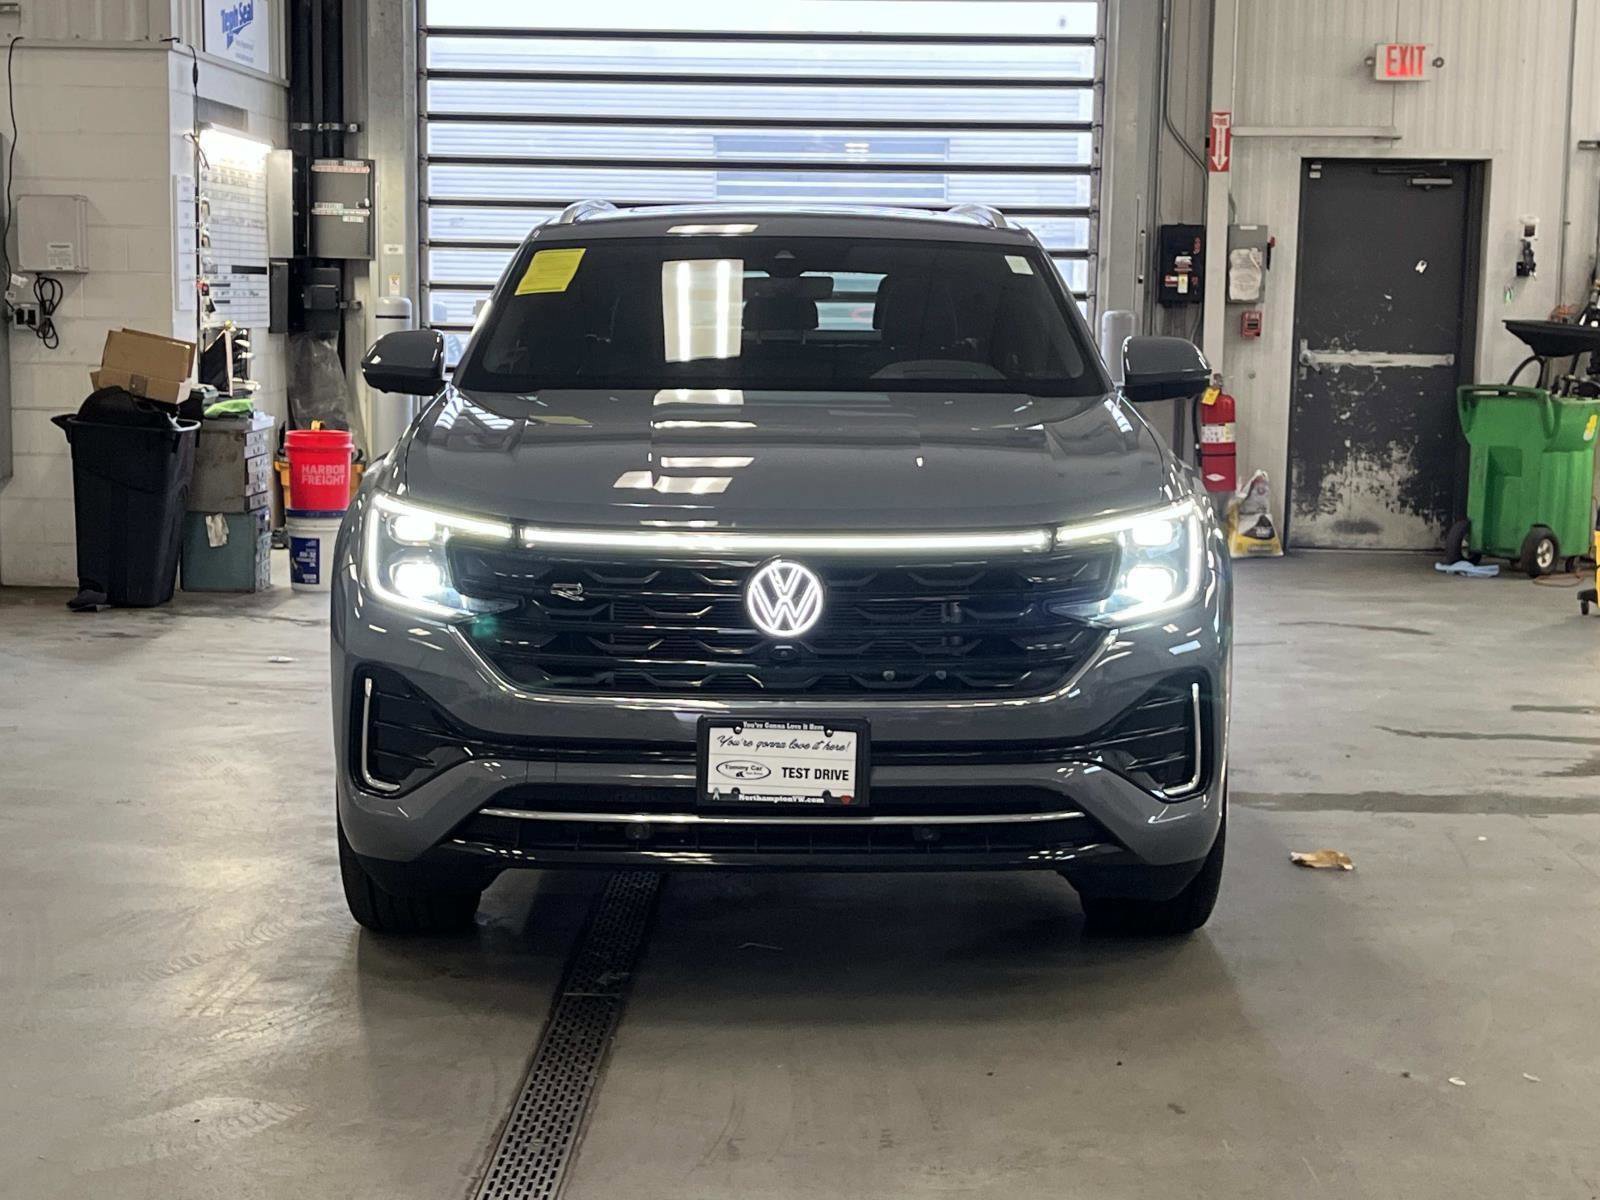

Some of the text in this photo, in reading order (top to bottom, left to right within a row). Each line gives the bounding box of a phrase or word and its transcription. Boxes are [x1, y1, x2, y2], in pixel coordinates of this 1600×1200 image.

[239, 0, 254, 26] Seal
[1386, 45, 1426, 77] EXIT
[302, 464, 346, 474] HARBOR
[301, 474, 346, 485] FREIGHT
[717, 735, 851, 752] You're gonna love it here!
[781, 766, 849, 781] TEST DRIVE
[739, 793, 825, 804] NorthamptonVW.com
